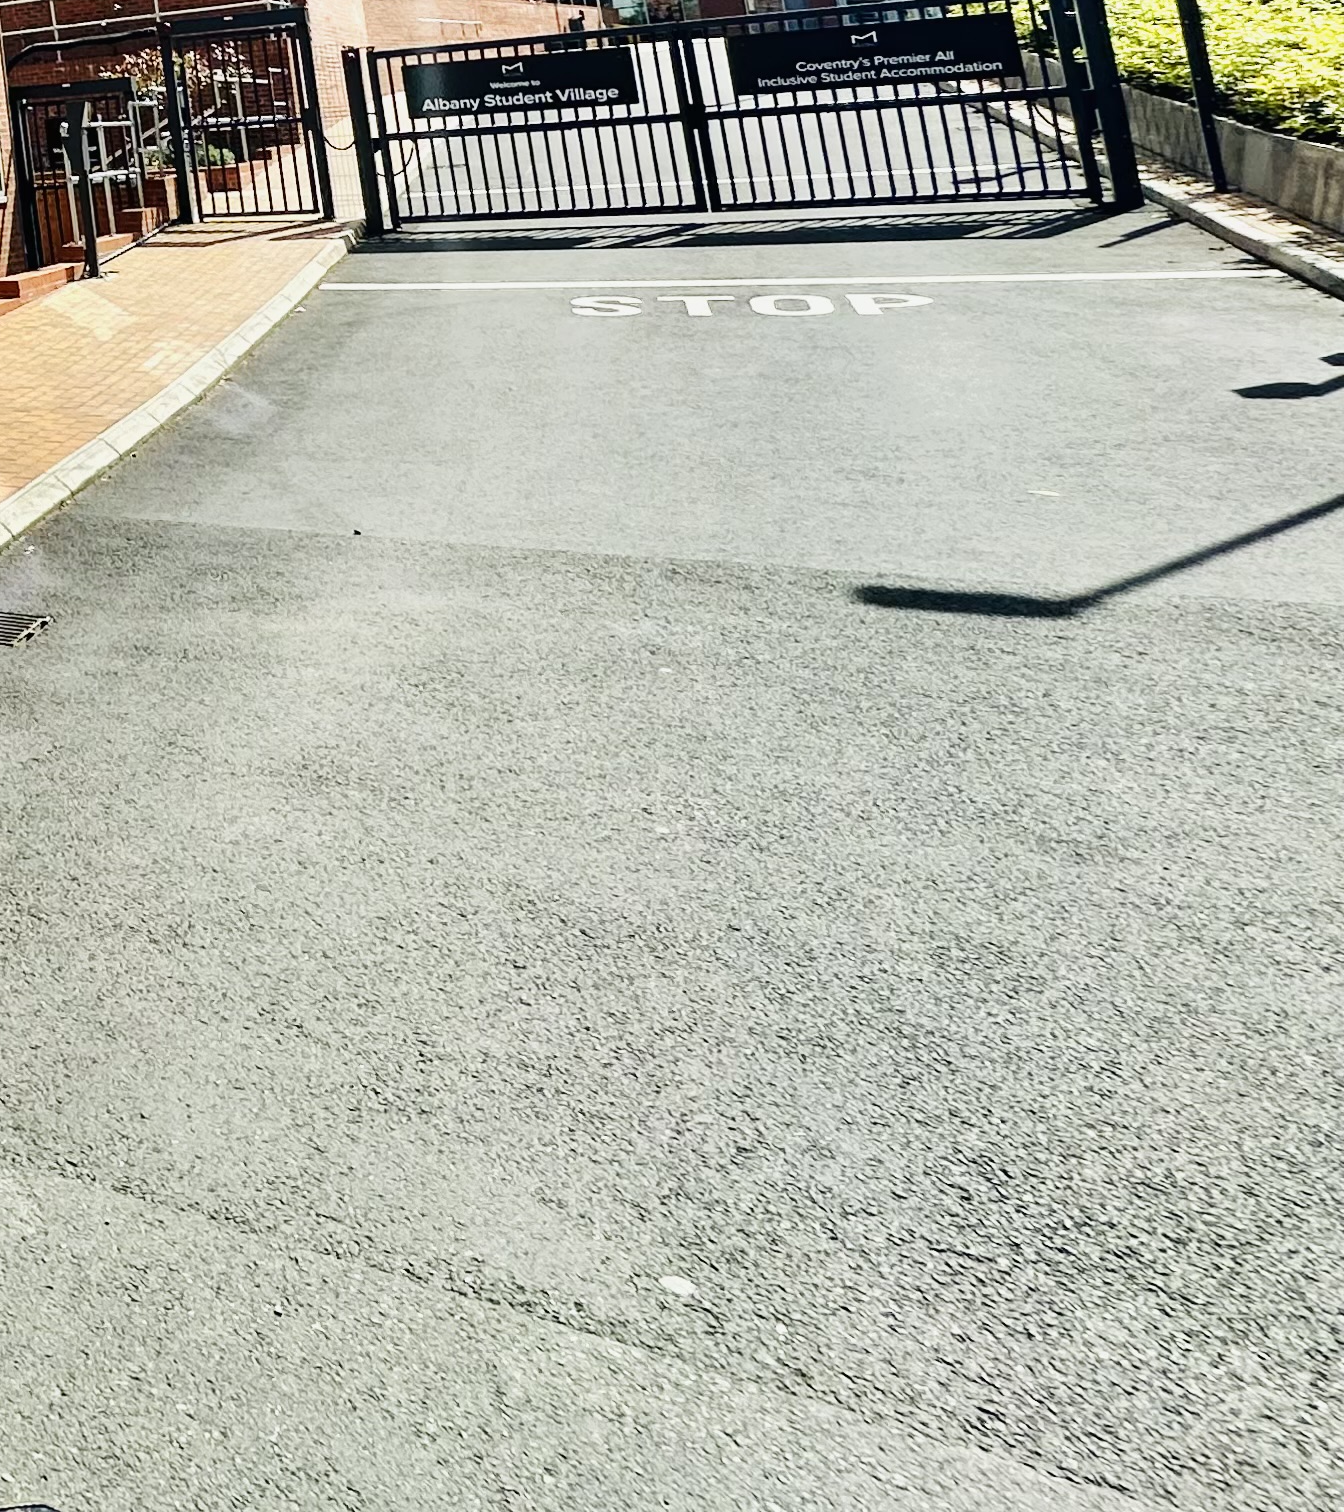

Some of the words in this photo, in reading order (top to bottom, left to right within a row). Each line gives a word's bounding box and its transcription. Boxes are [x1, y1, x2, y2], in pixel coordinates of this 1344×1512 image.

[757, 73, 818, 89] Inclusive
[819, 68, 878, 84] Student
[879, 59, 1004, 79] Accommodation
[795, 55, 871, 73] Coventry's
[873, 53, 932, 66] Premier
[933, 50, 955, 62] All
[489, 79, 524, 90] Welcome
[529, 79, 541, 87] to
[421, 96, 481, 113] Albany
[483, 90, 554, 108] Student
[555, 87, 620, 103] Village
[569, 292, 936, 317] STOP
